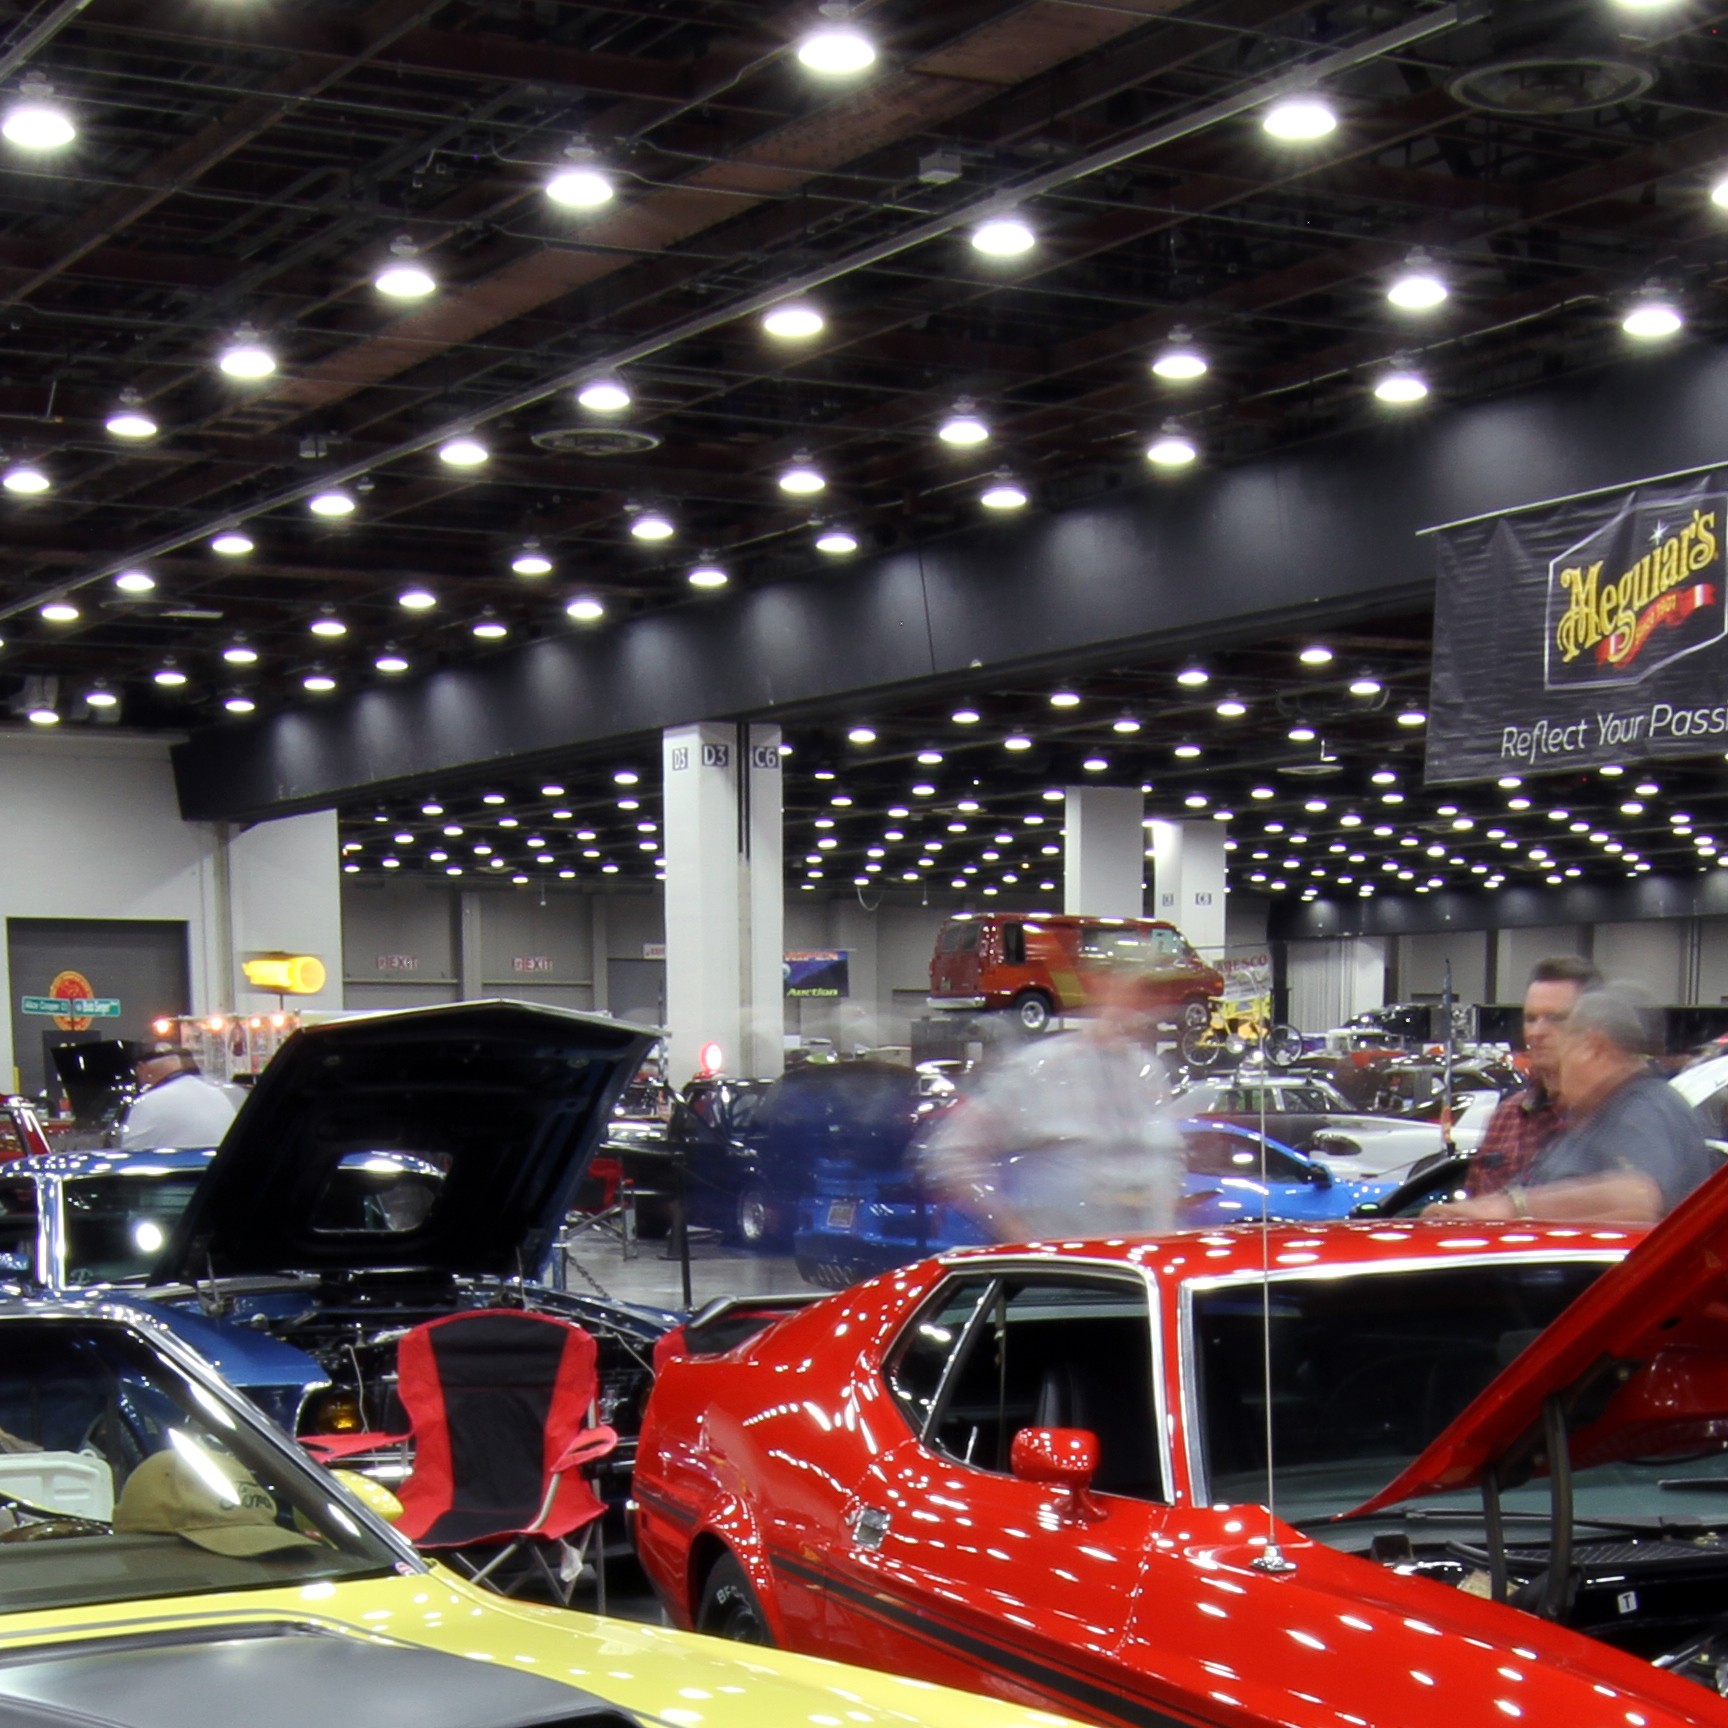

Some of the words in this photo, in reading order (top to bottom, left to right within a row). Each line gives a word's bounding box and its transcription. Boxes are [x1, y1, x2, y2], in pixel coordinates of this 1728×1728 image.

[1557, 509, 1716, 663] Meguiar's
[1501, 720, 1585, 763] Reflect
[1596, 713, 1640, 744] Your
[675, 748, 686, 769] D3
[704, 745, 726, 765] D3
[755, 748, 776, 767] C6
[787, 987, 839, 997] Auction
